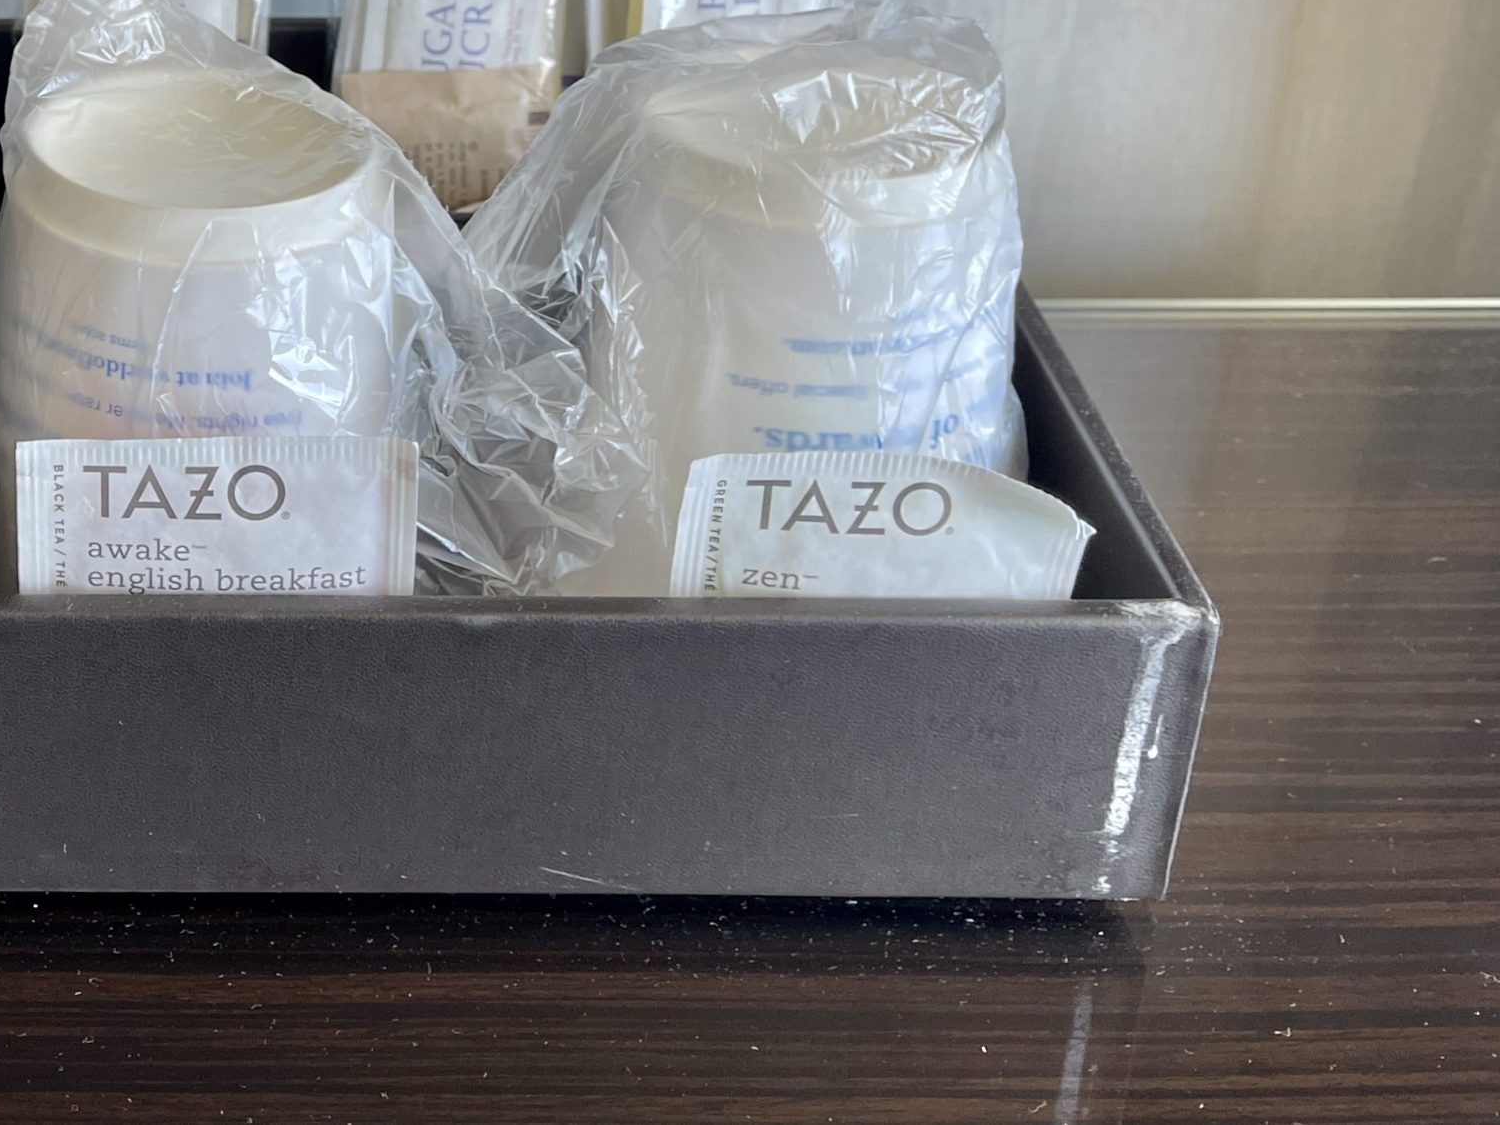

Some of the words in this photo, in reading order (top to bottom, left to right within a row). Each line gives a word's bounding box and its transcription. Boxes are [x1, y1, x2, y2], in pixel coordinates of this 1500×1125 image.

[176, 372, 199, 388] at
[53, 464, 65, 513] BLACK
[82, 464, 287, 521] TAZO
[710, 479, 728, 523] GREEN
[746, 479, 953, 537] TAZO
[54, 519, 66, 545] TEA
[707, 528, 721, 553] TEA
[87, 567, 204, 595] english
[215, 565, 367, 592] breakfast
